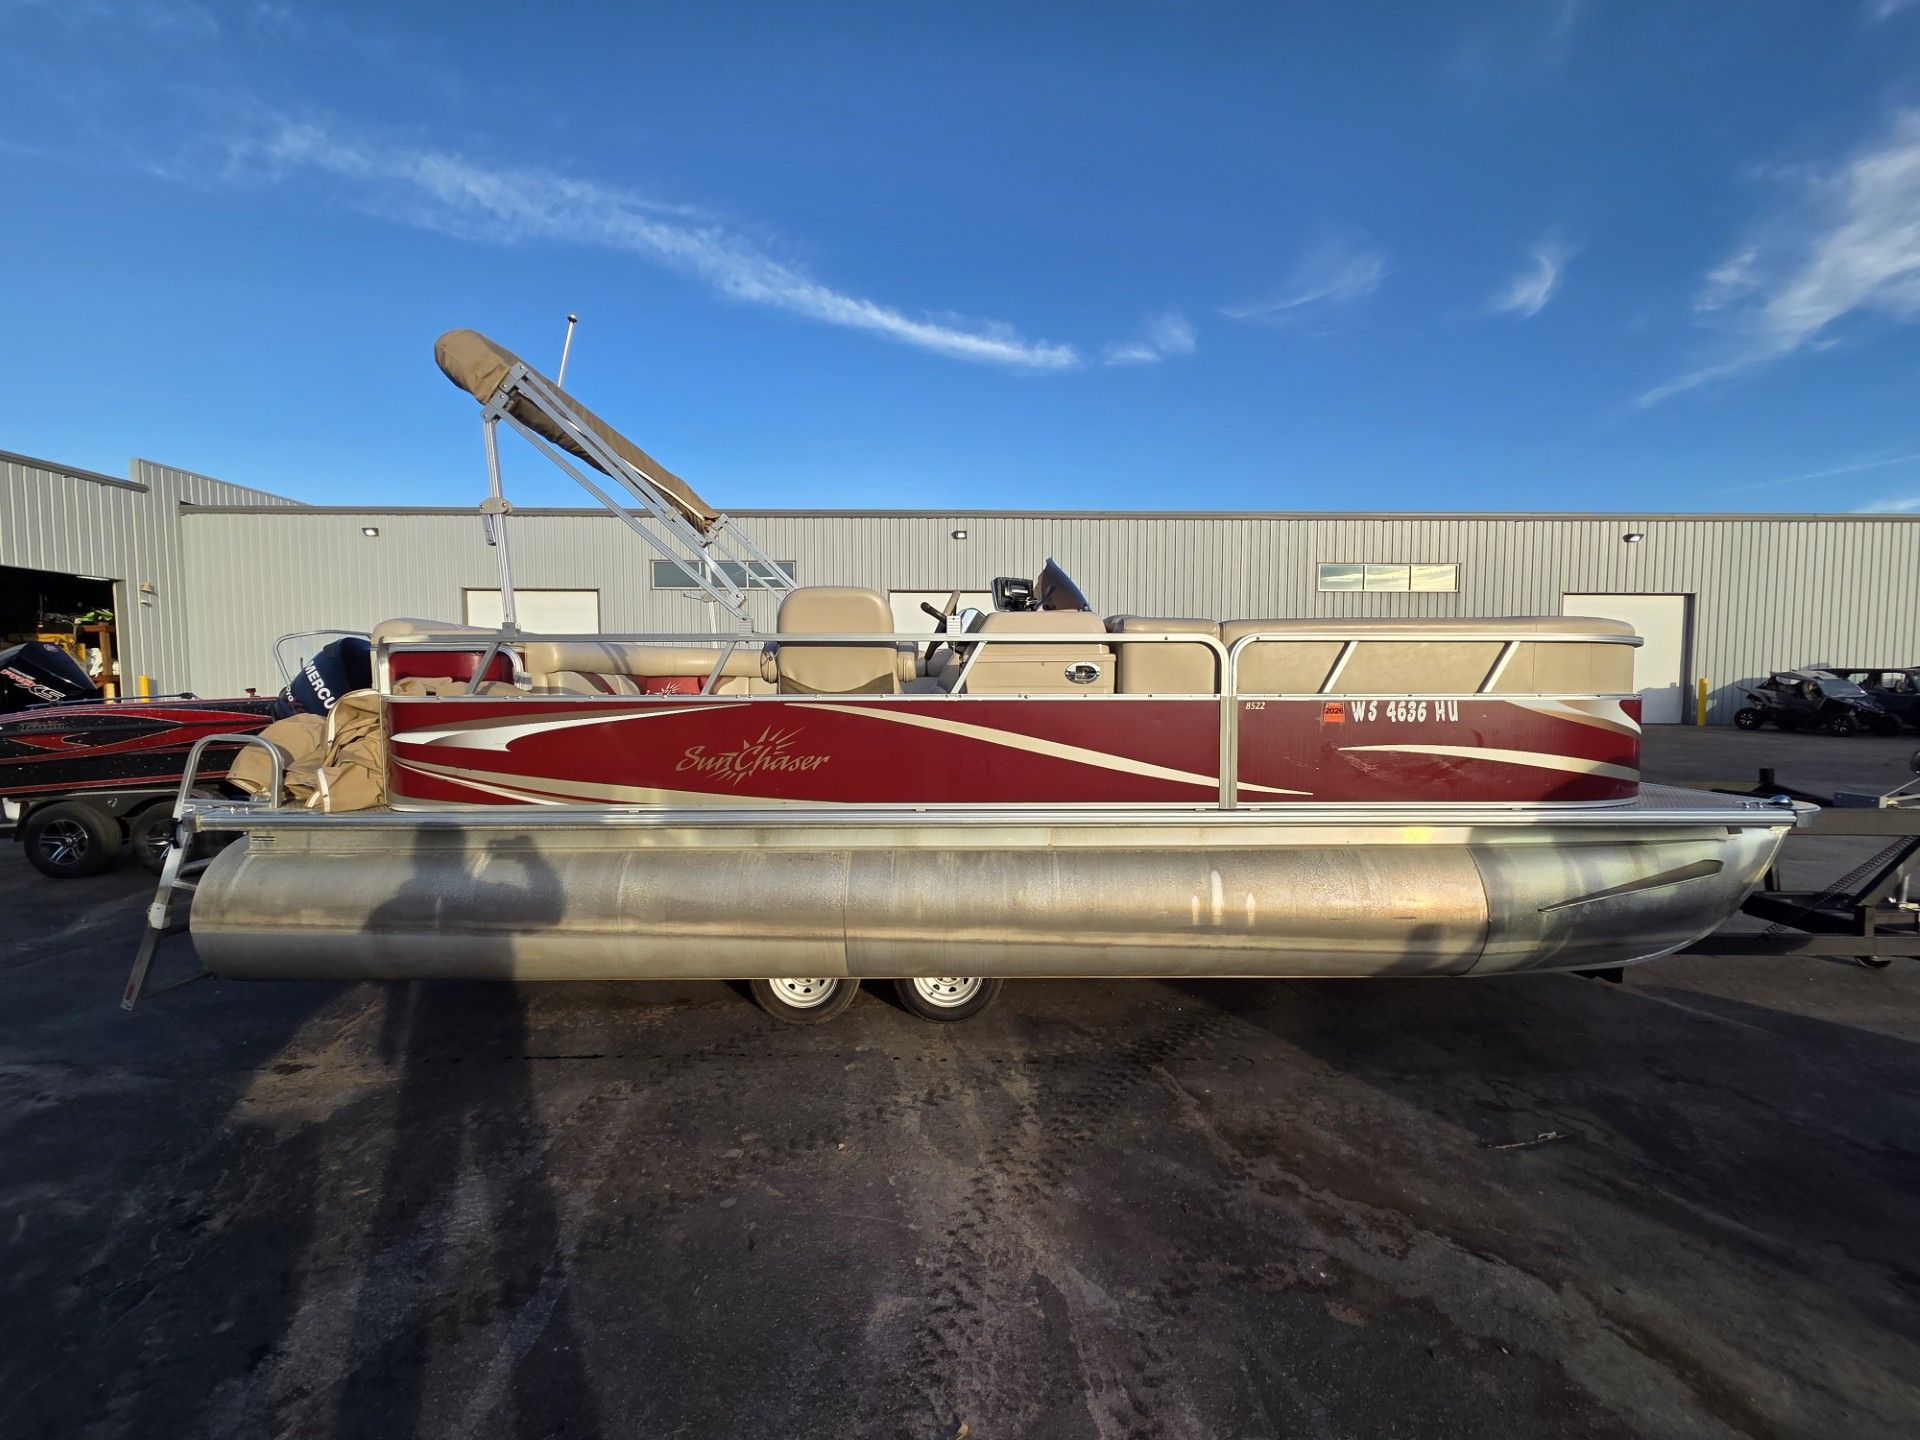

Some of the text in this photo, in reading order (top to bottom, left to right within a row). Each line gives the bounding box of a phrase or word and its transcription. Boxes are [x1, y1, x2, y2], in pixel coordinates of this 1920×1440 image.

[304, 660, 335, 709] MERCU
[1245, 702, 1266, 710] 8522
[1351, 700, 1459, 722] WS 4636 HU
[675, 745, 831, 777] SunChaser
